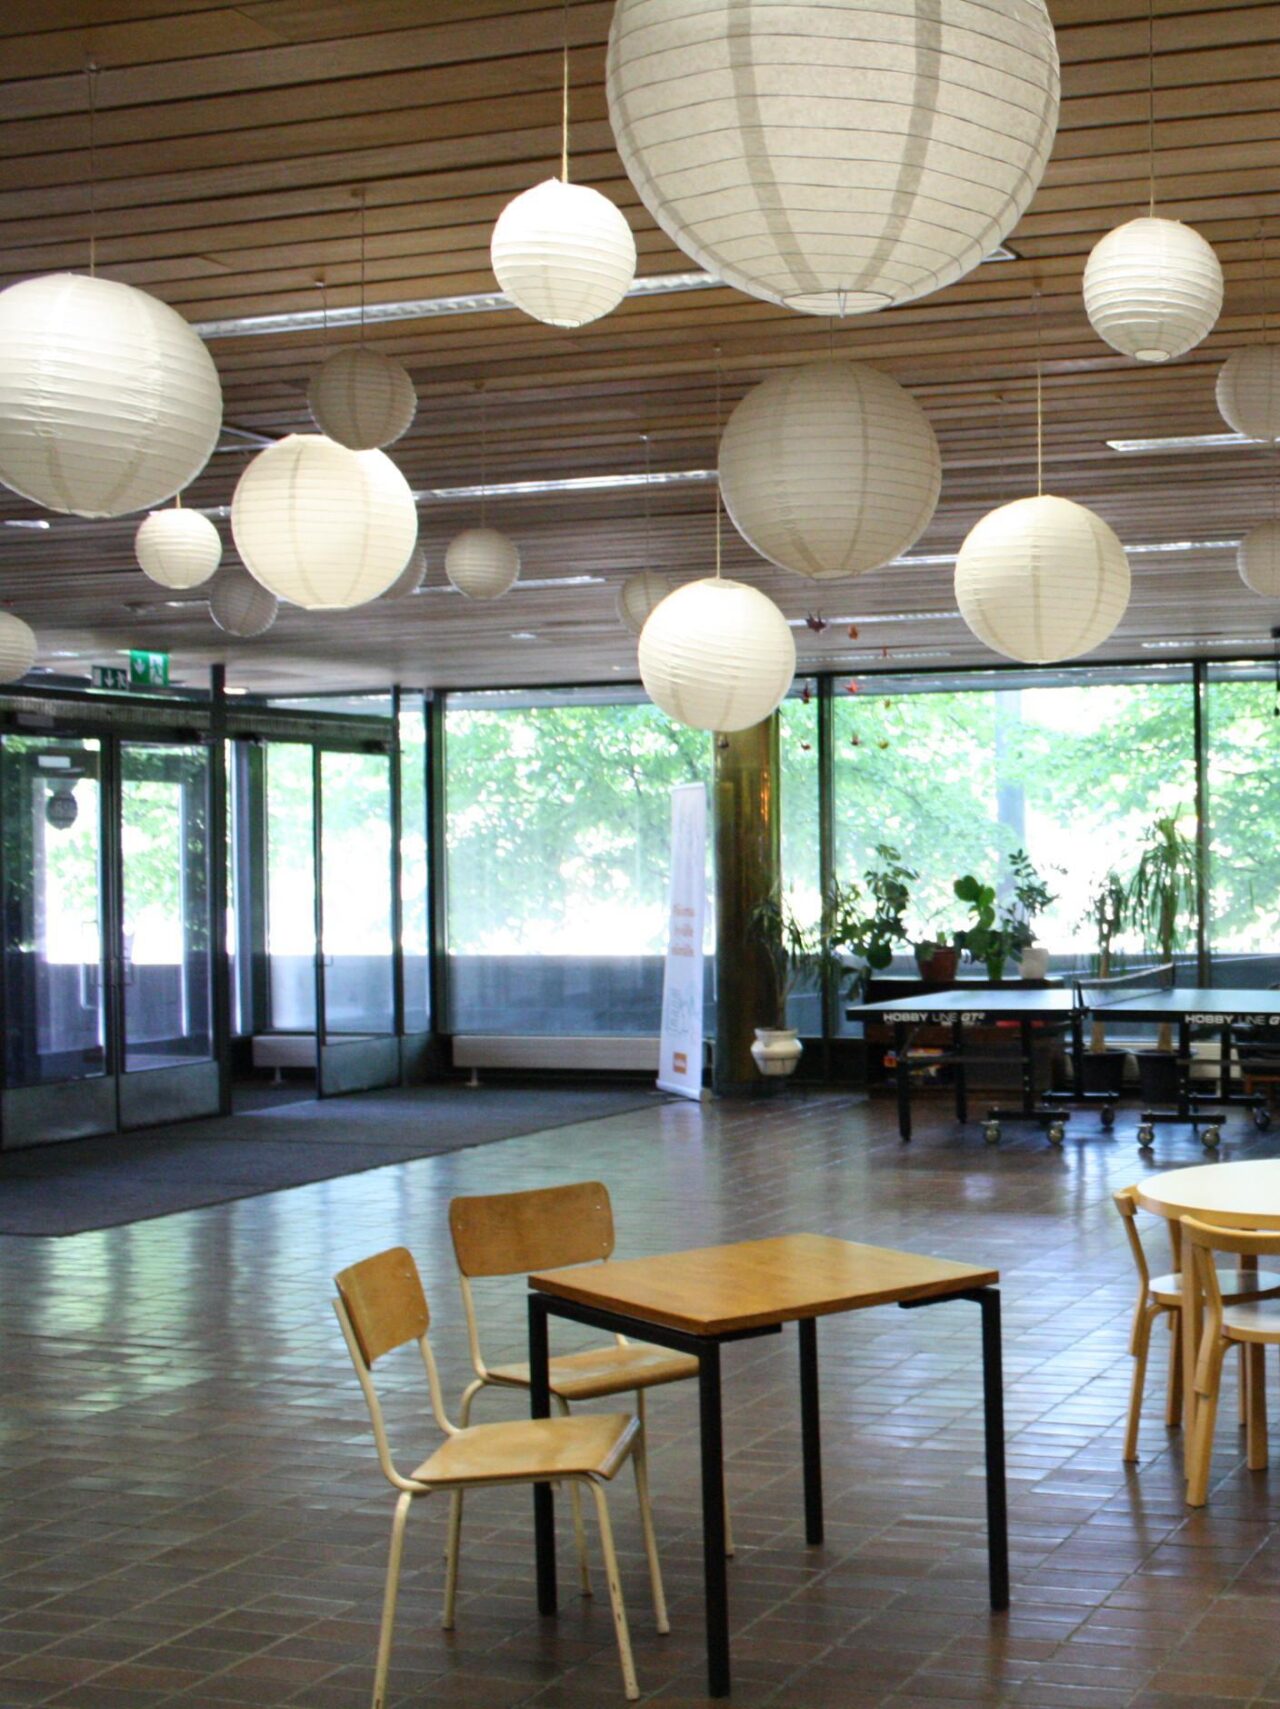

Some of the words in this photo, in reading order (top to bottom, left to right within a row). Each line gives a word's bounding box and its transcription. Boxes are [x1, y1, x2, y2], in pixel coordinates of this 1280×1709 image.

[882, 1011, 929, 1022] HOBBY
[931, 1011, 958, 1022] LINE
[1184, 1013, 1235, 1025] HOBBY
[1237, 1014, 1266, 1026] LINE
